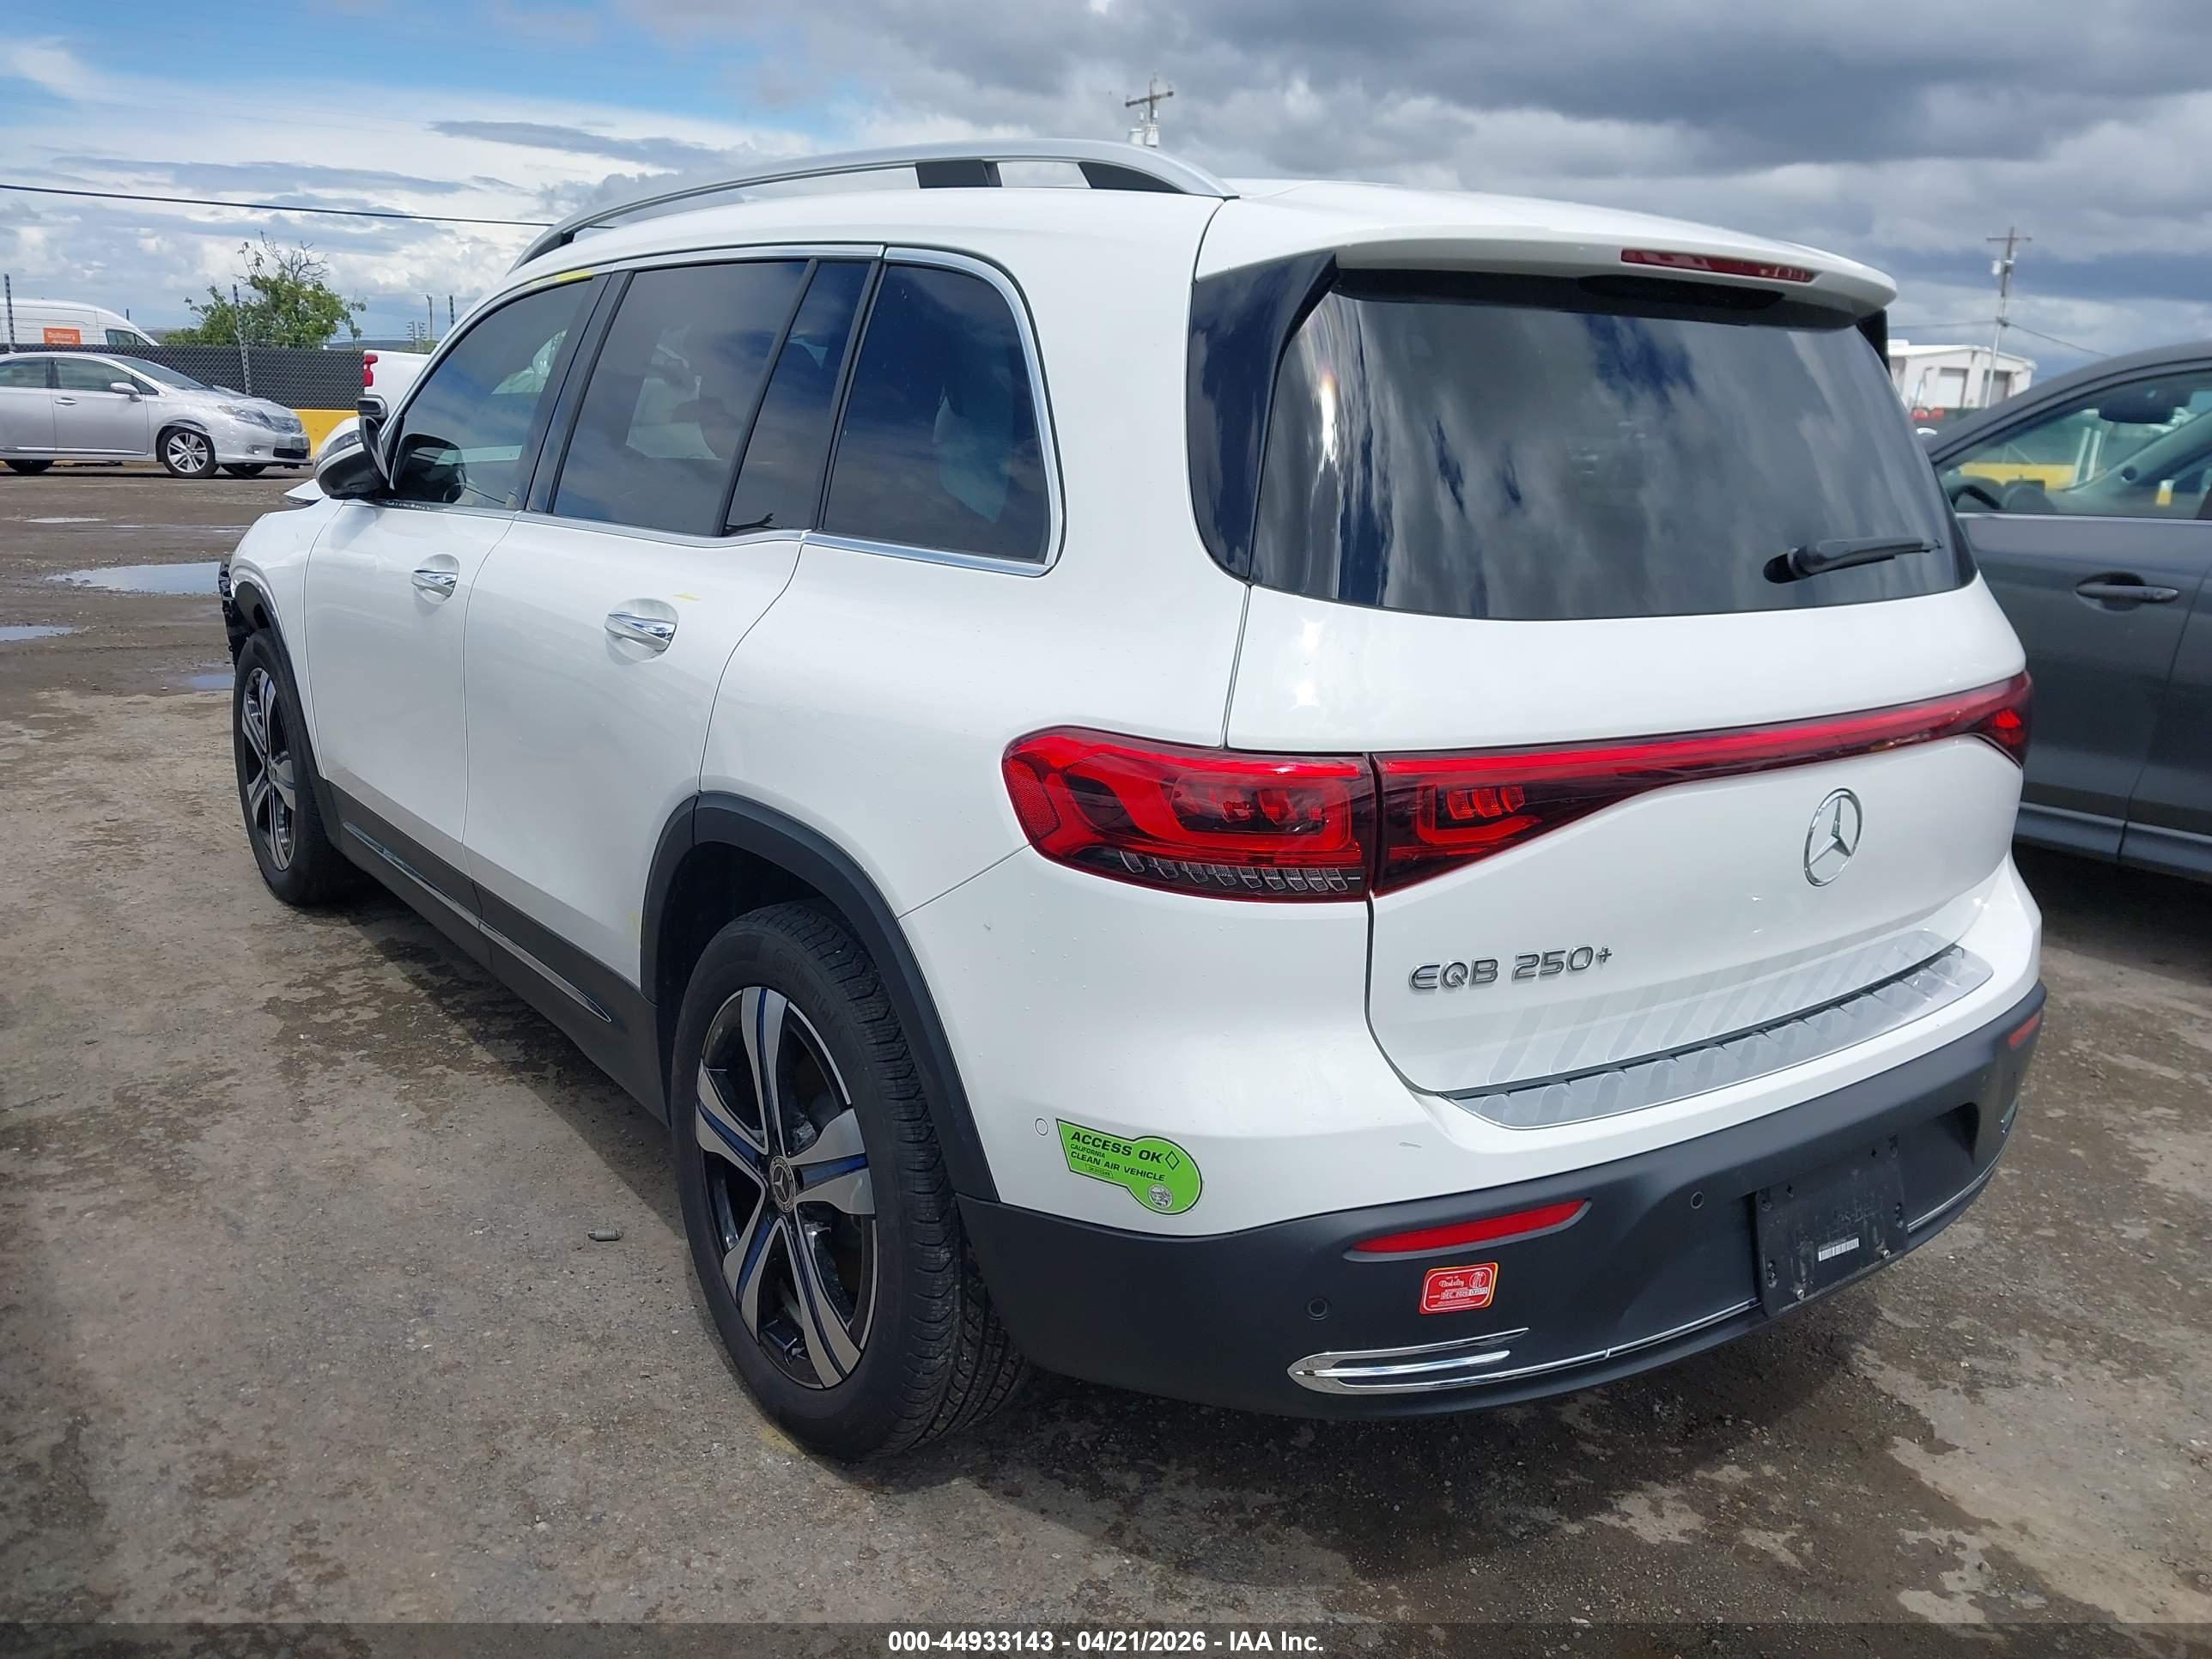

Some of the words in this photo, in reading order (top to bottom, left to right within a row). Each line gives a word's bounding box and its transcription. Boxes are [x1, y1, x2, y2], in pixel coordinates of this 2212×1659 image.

[1408, 956, 1498, 990] EQB
[1511, 945, 1613, 981] 250+
[1070, 1131, 1133, 1156] ACCESS
[1139, 1149, 1164, 1164] OK
[1070, 1143, 1105, 1158] CALIFORNIA
[1071, 1151, 1102, 1165] CLEAN
[1103, 1161, 1120, 1171] AIR
[1124, 1165, 1165, 1182] VEHICLE
